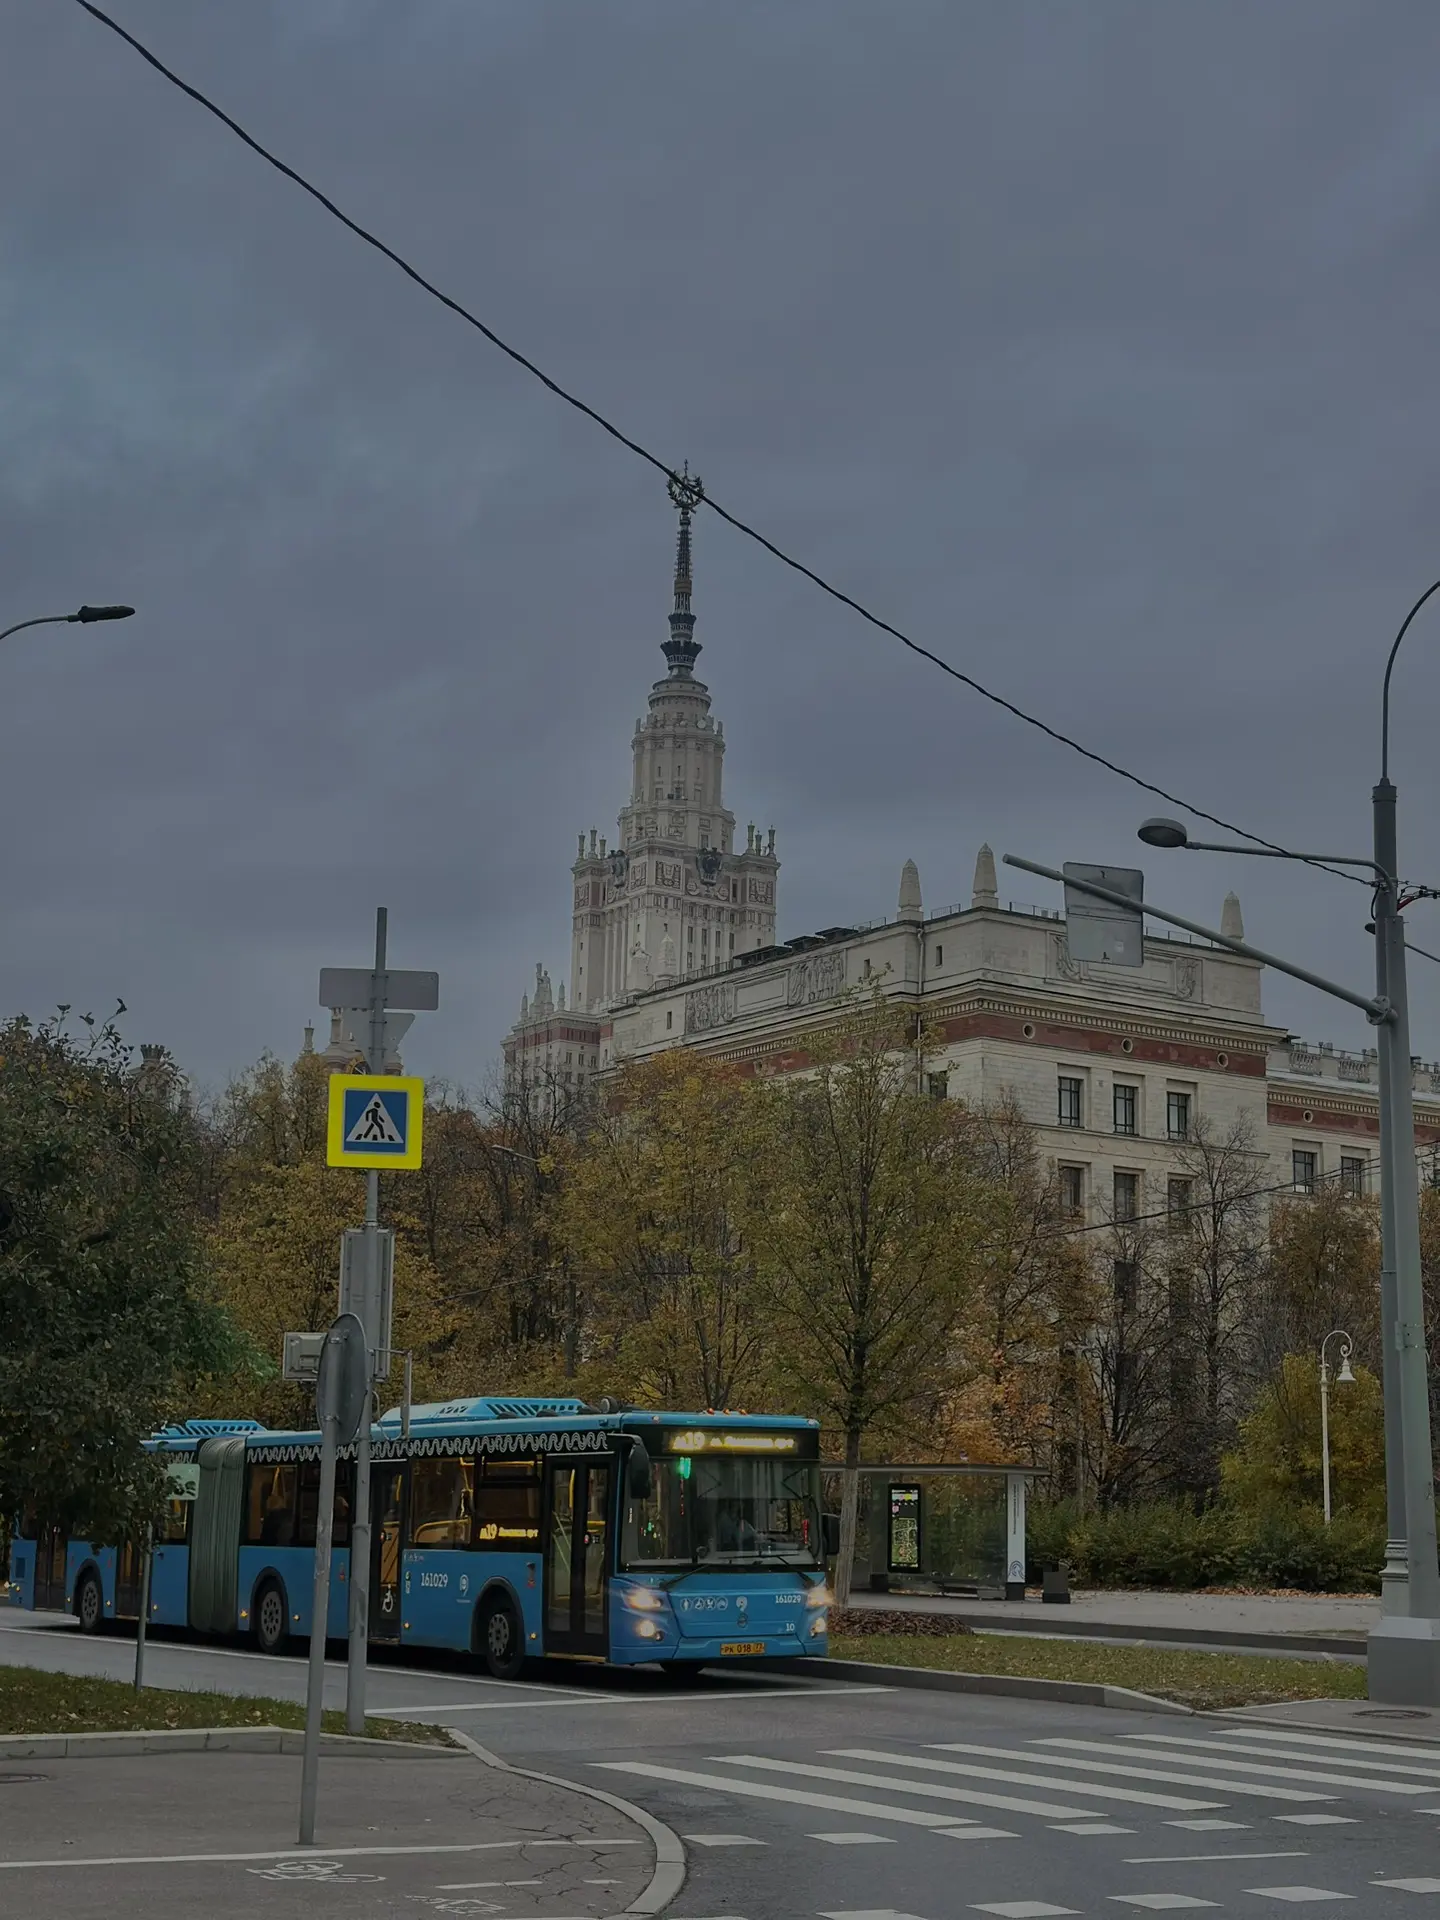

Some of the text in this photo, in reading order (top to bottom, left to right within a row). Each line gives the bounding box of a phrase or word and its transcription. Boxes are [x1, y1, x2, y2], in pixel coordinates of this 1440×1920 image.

[421, 1572, 448, 1588] 161029
[775, 1595, 801, 1604] 161029
[785, 1623, 795, 1631] 10
[736, 1643, 752, 1653] 018
